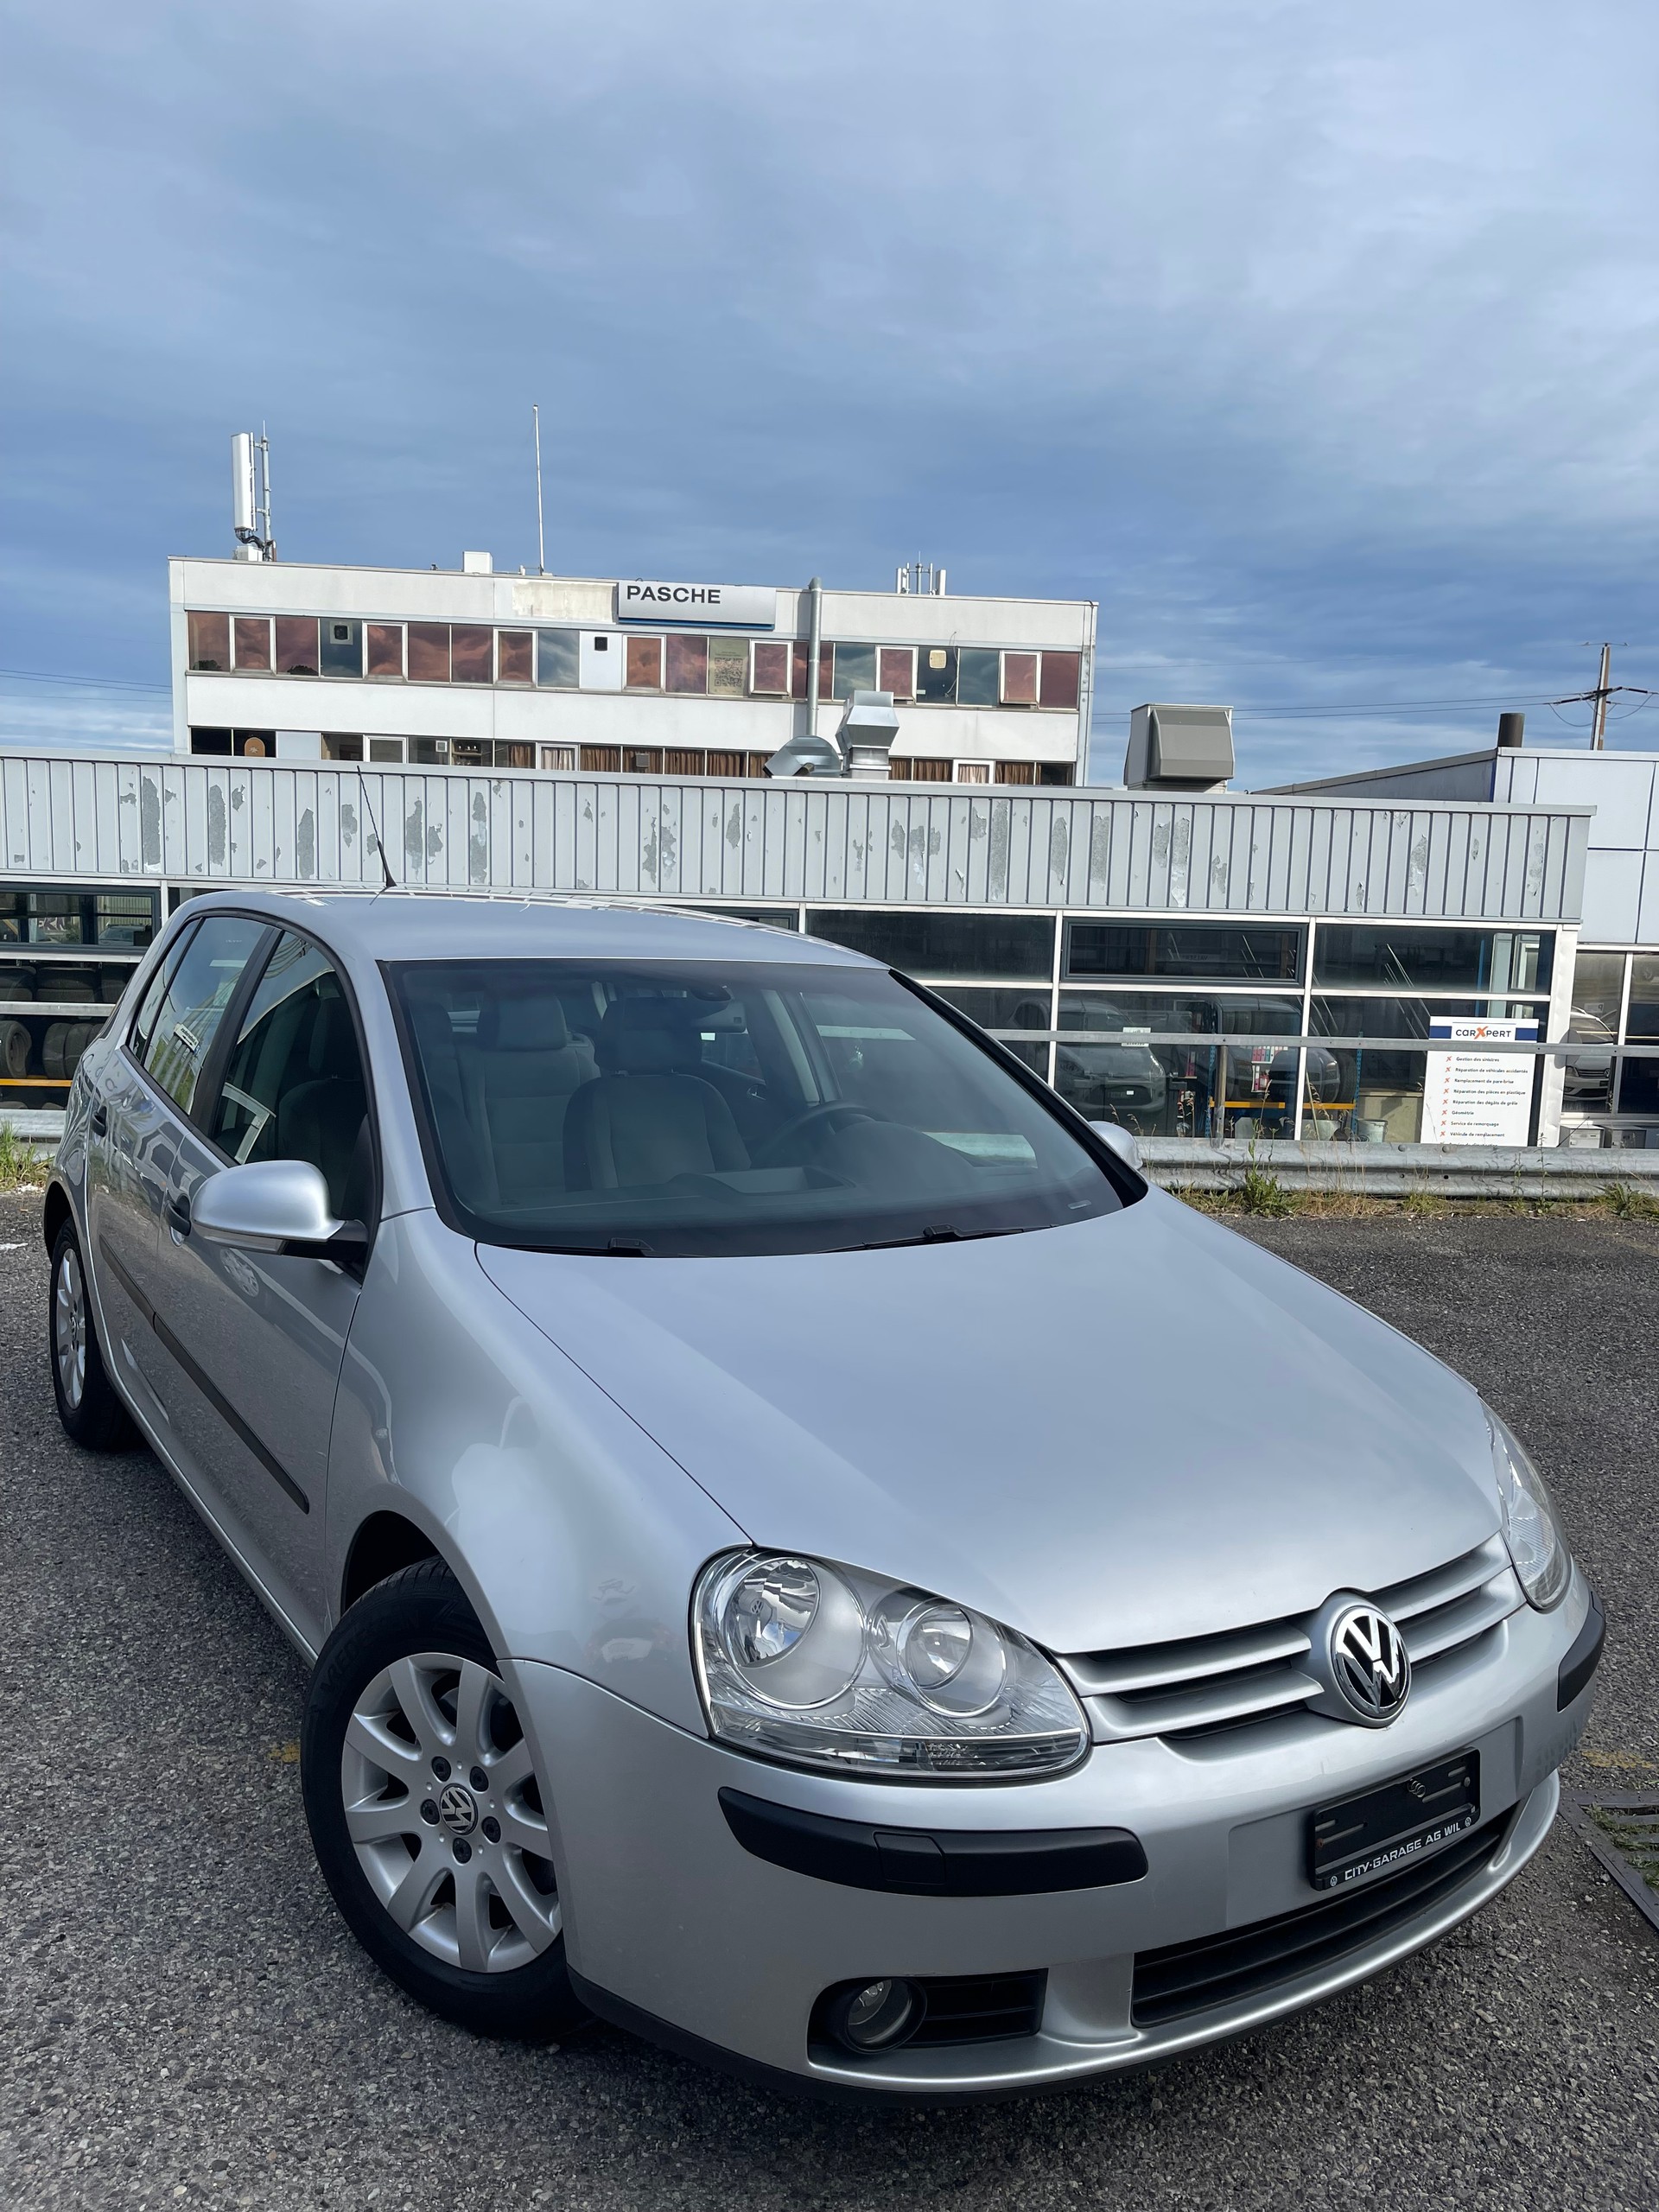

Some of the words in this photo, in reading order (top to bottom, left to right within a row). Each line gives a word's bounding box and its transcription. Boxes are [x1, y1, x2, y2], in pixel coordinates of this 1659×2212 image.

[626, 585, 721, 604] PASCHE
[1344, 1839, 1422, 1881] CITY-GARAGE
[1425, 1830, 1441, 1846] AG
[1444, 1821, 1461, 1837] WIL
